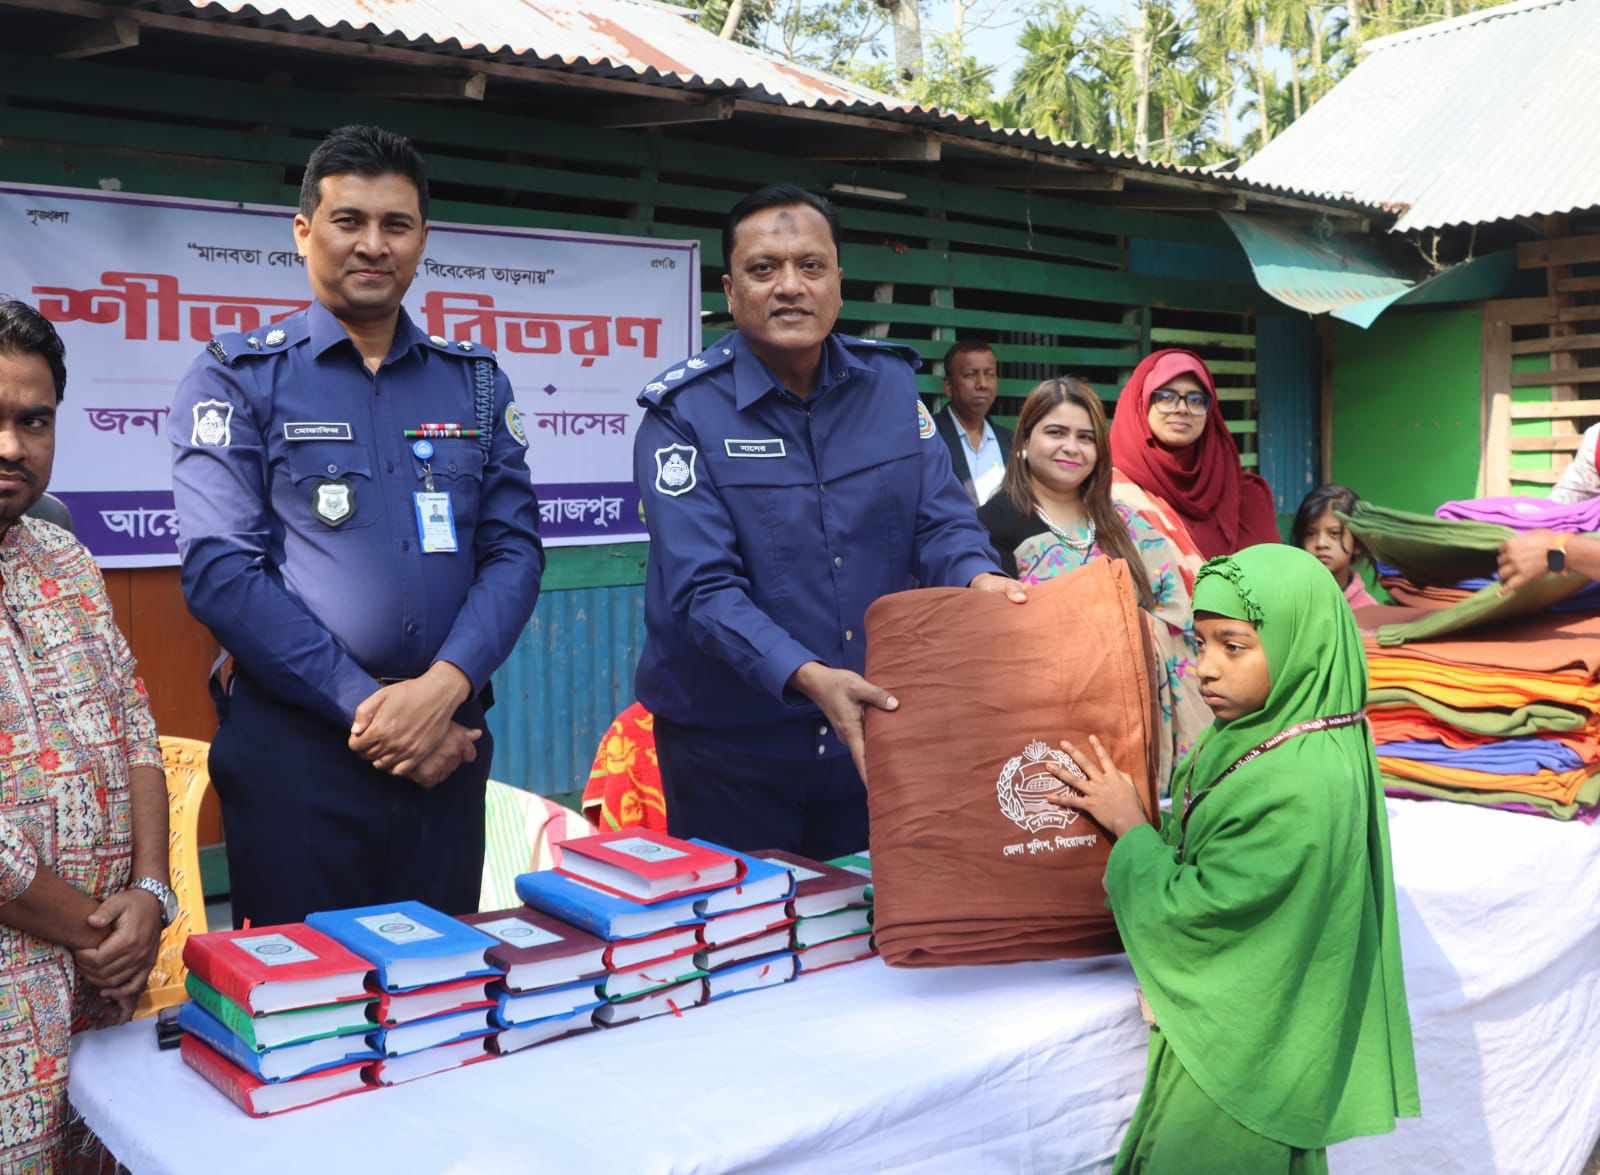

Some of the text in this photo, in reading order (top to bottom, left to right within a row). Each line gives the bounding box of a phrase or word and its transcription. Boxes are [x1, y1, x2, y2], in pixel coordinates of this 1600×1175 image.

[424, 257, 486, 281] বিবেকের
[32, 271, 662, 367] শীত বিতরণ
[533, 410, 630, 436] নাসের
[537, 496, 624, 527] রাজপুর
